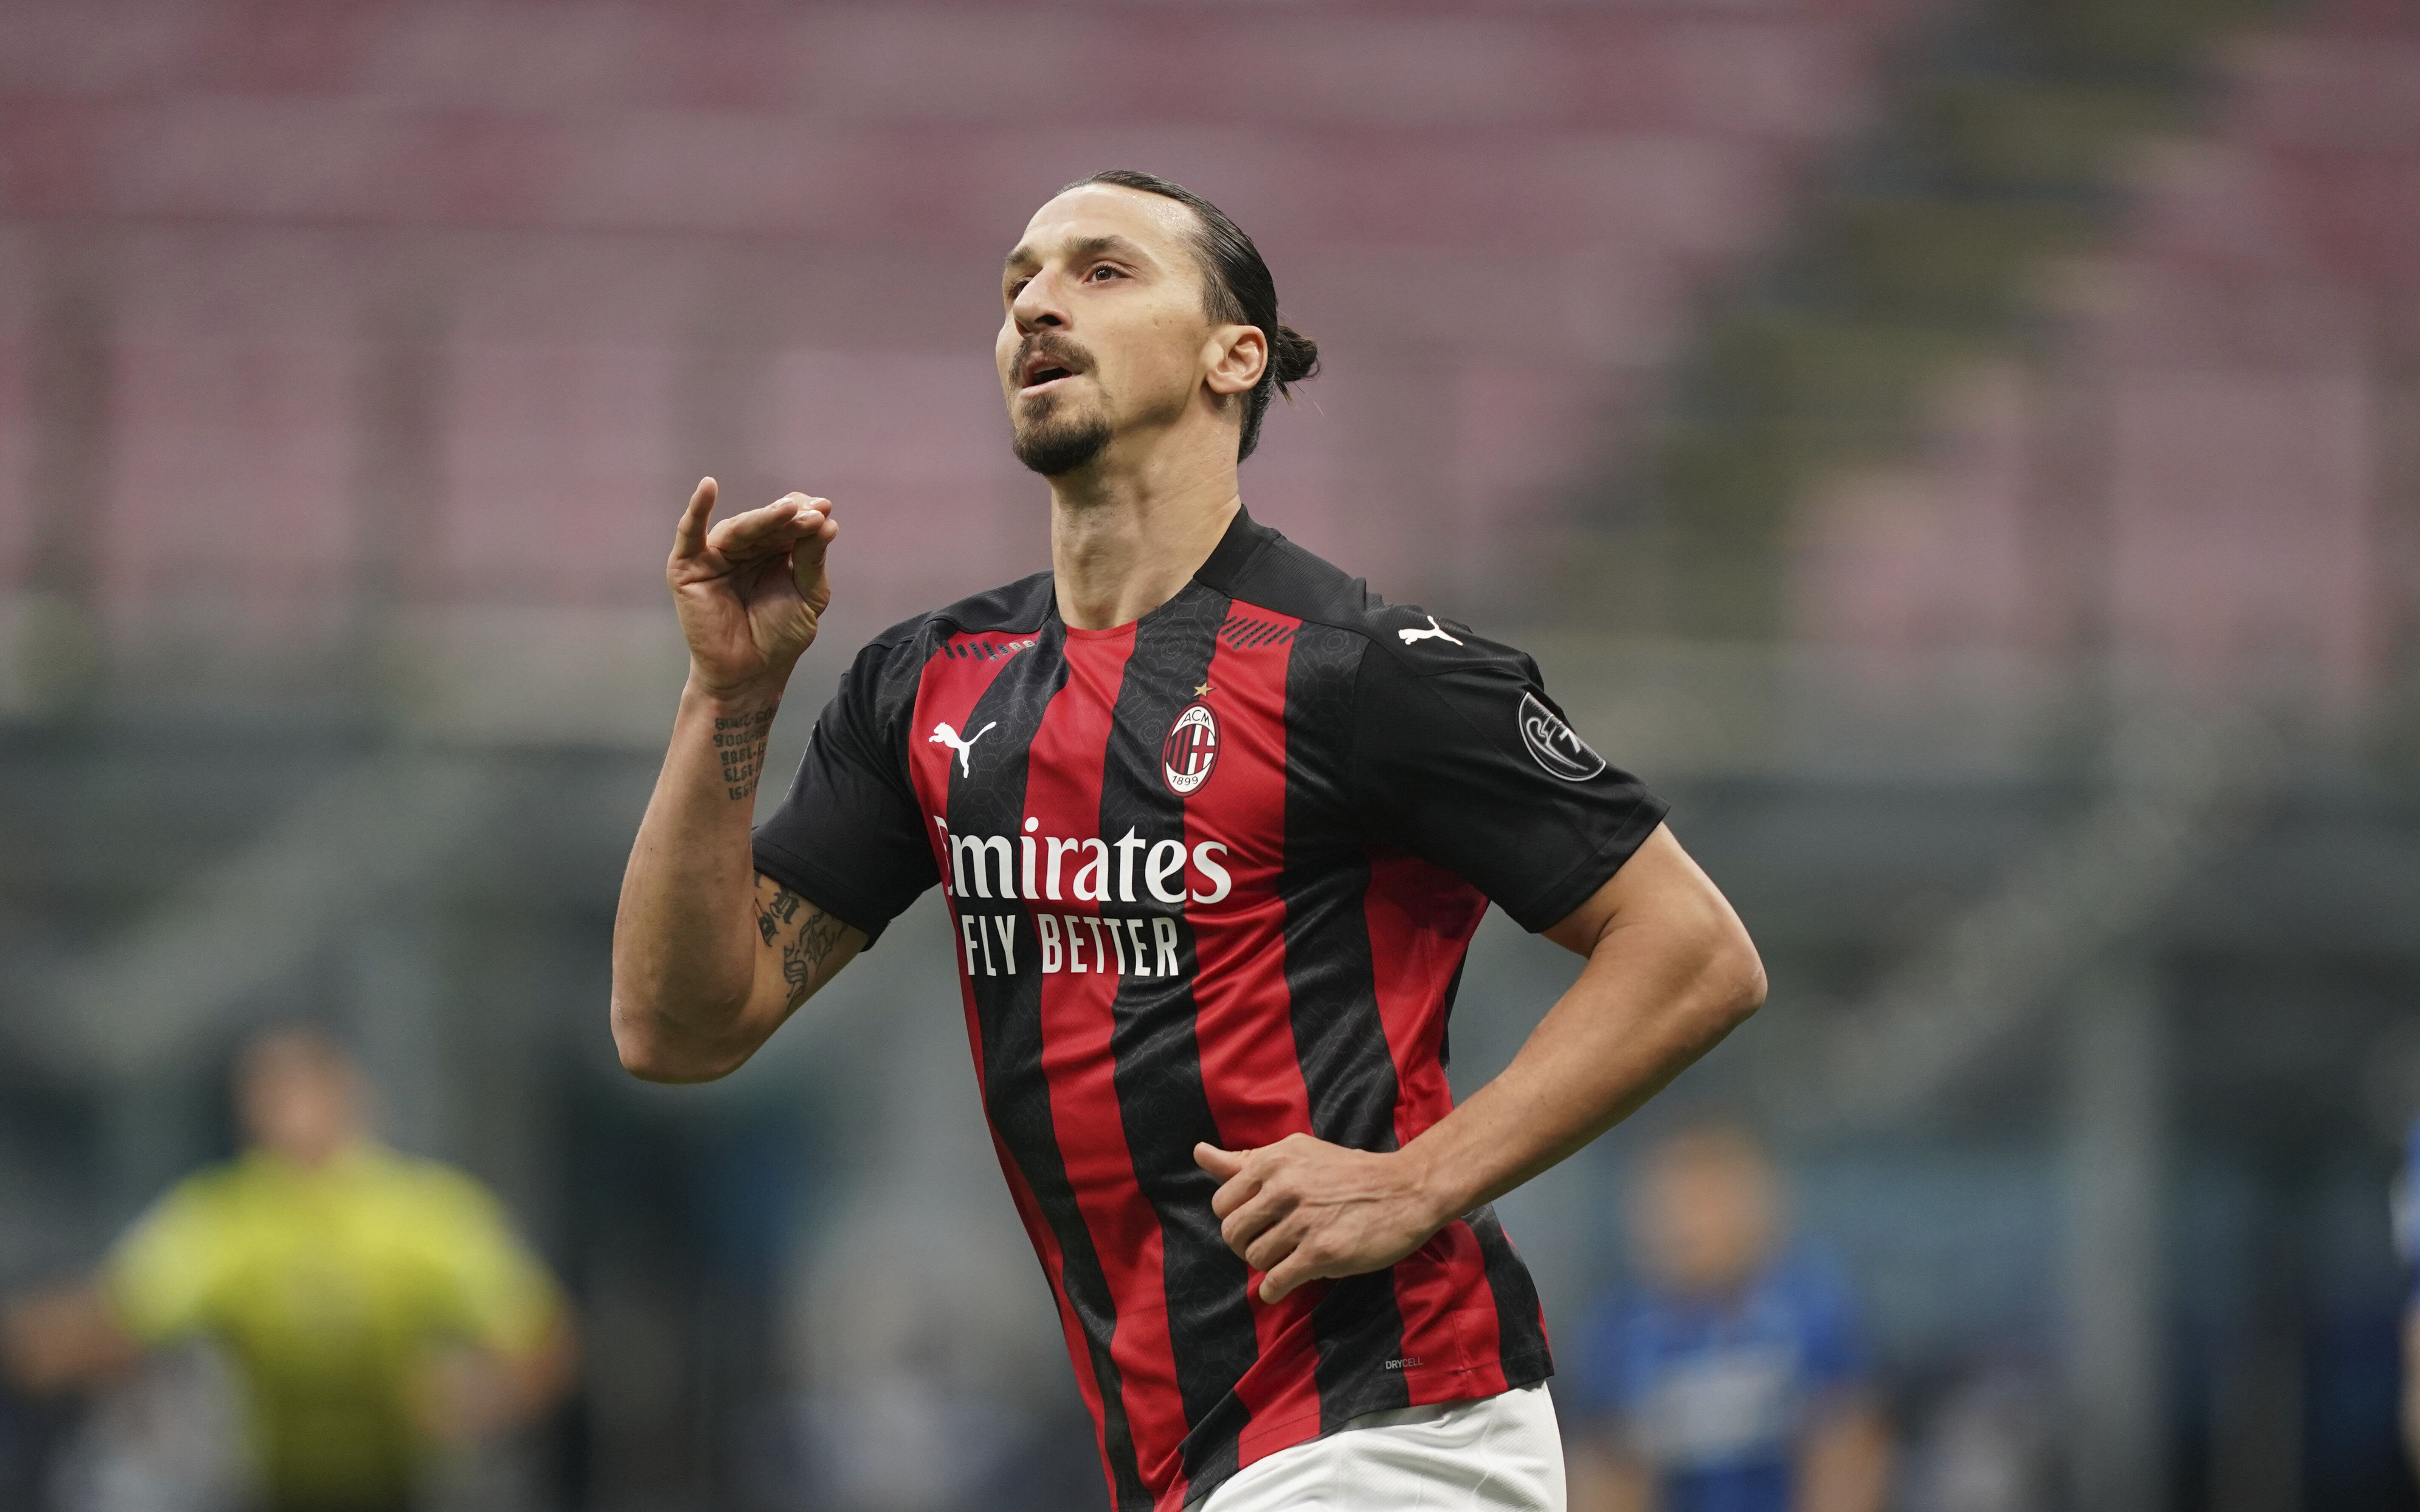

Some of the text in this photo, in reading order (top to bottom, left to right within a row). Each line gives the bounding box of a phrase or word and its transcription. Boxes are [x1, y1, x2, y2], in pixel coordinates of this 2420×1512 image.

[1180, 709, 1210, 726] ACM
[1172, 775, 1198, 785] 1899
[962, 913, 1179, 977] FLY BETTER
[1385, 1357, 1423, 1369] DRYCELL
